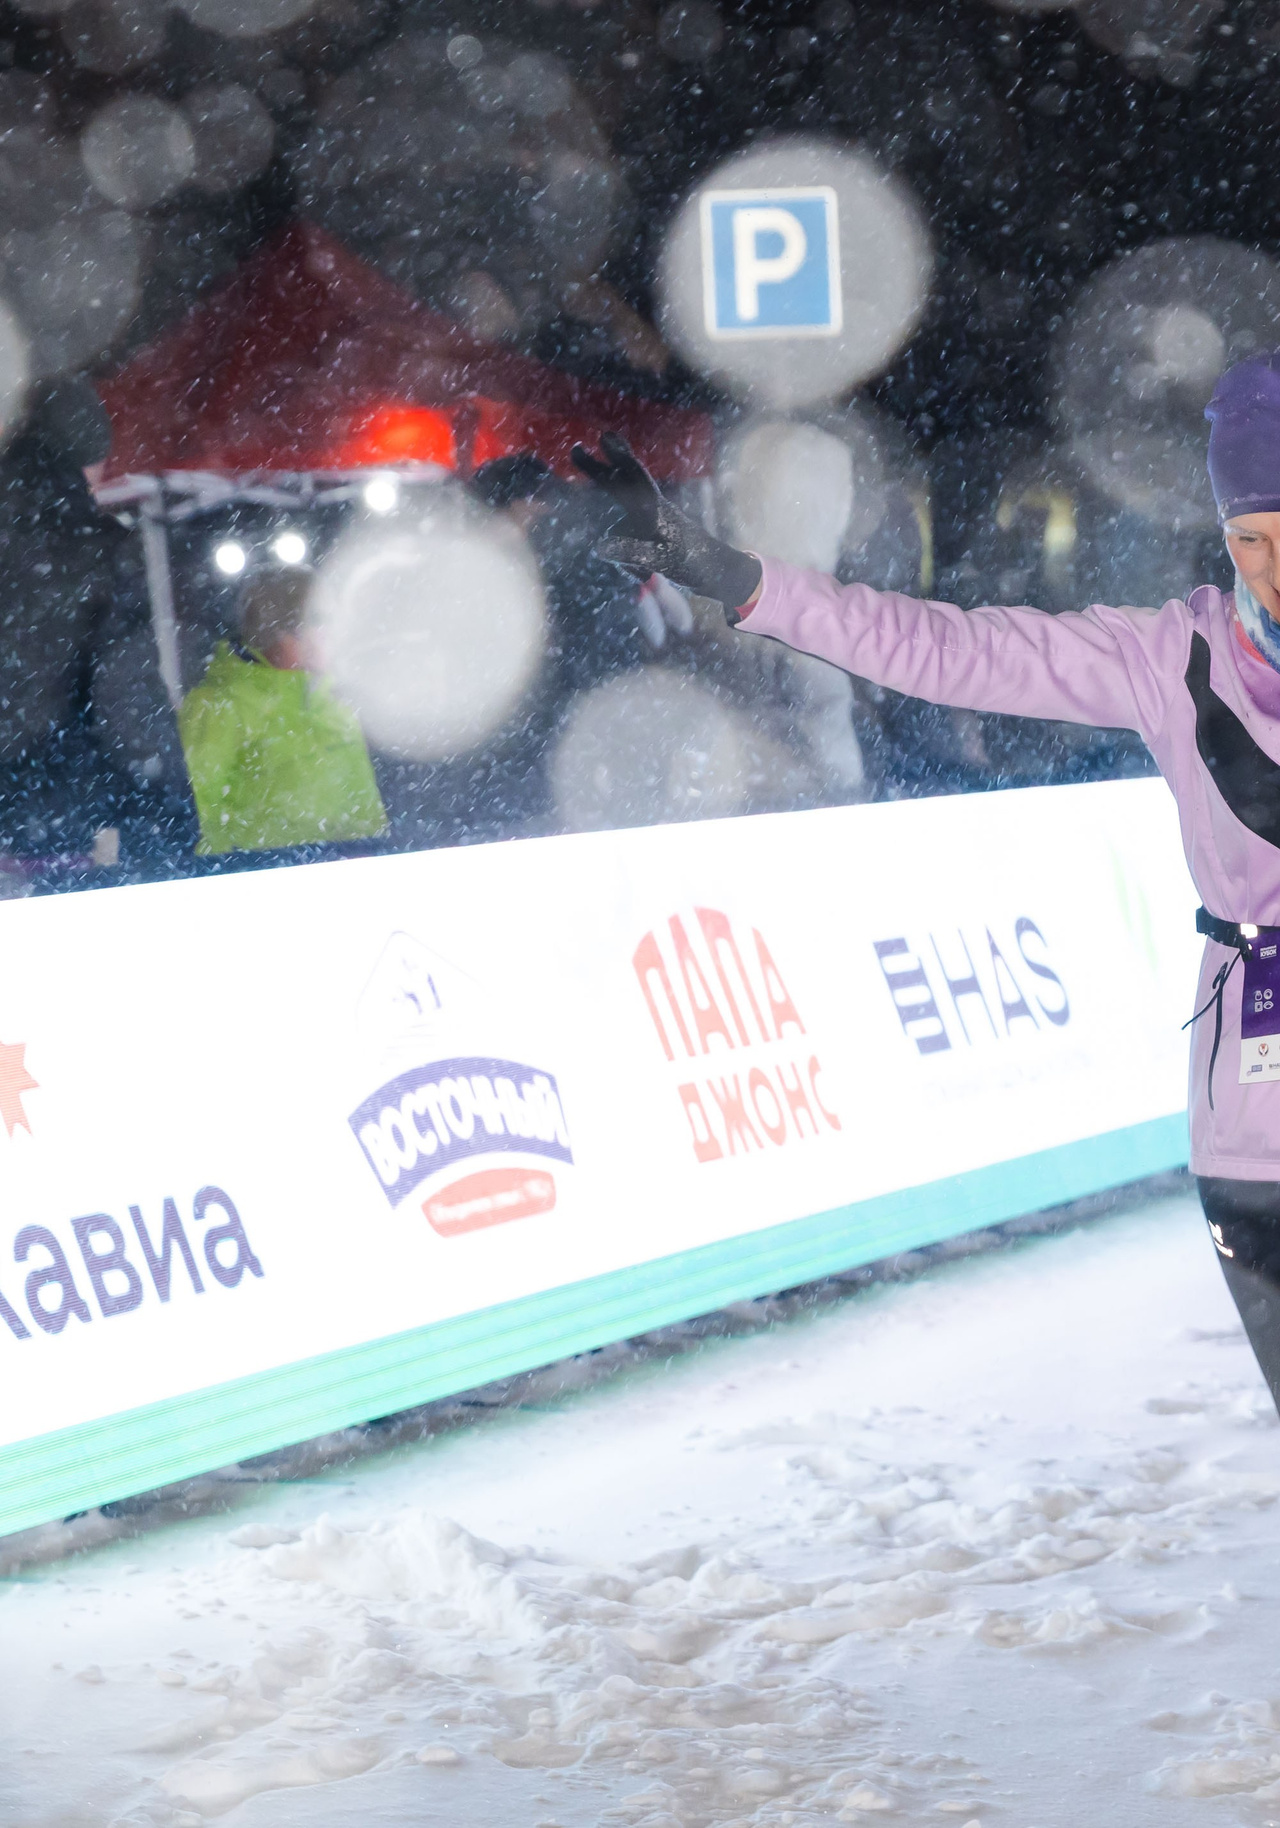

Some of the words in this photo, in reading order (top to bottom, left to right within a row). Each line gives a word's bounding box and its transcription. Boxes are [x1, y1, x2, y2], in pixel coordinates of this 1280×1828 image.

[733, 207, 807, 321] P
[632, 905, 806, 1062] ПАПА
[359, 1074, 571, 1188] ВОСТОЧНЫЙ
[677, 1054, 842, 1163] ДЖОНС
